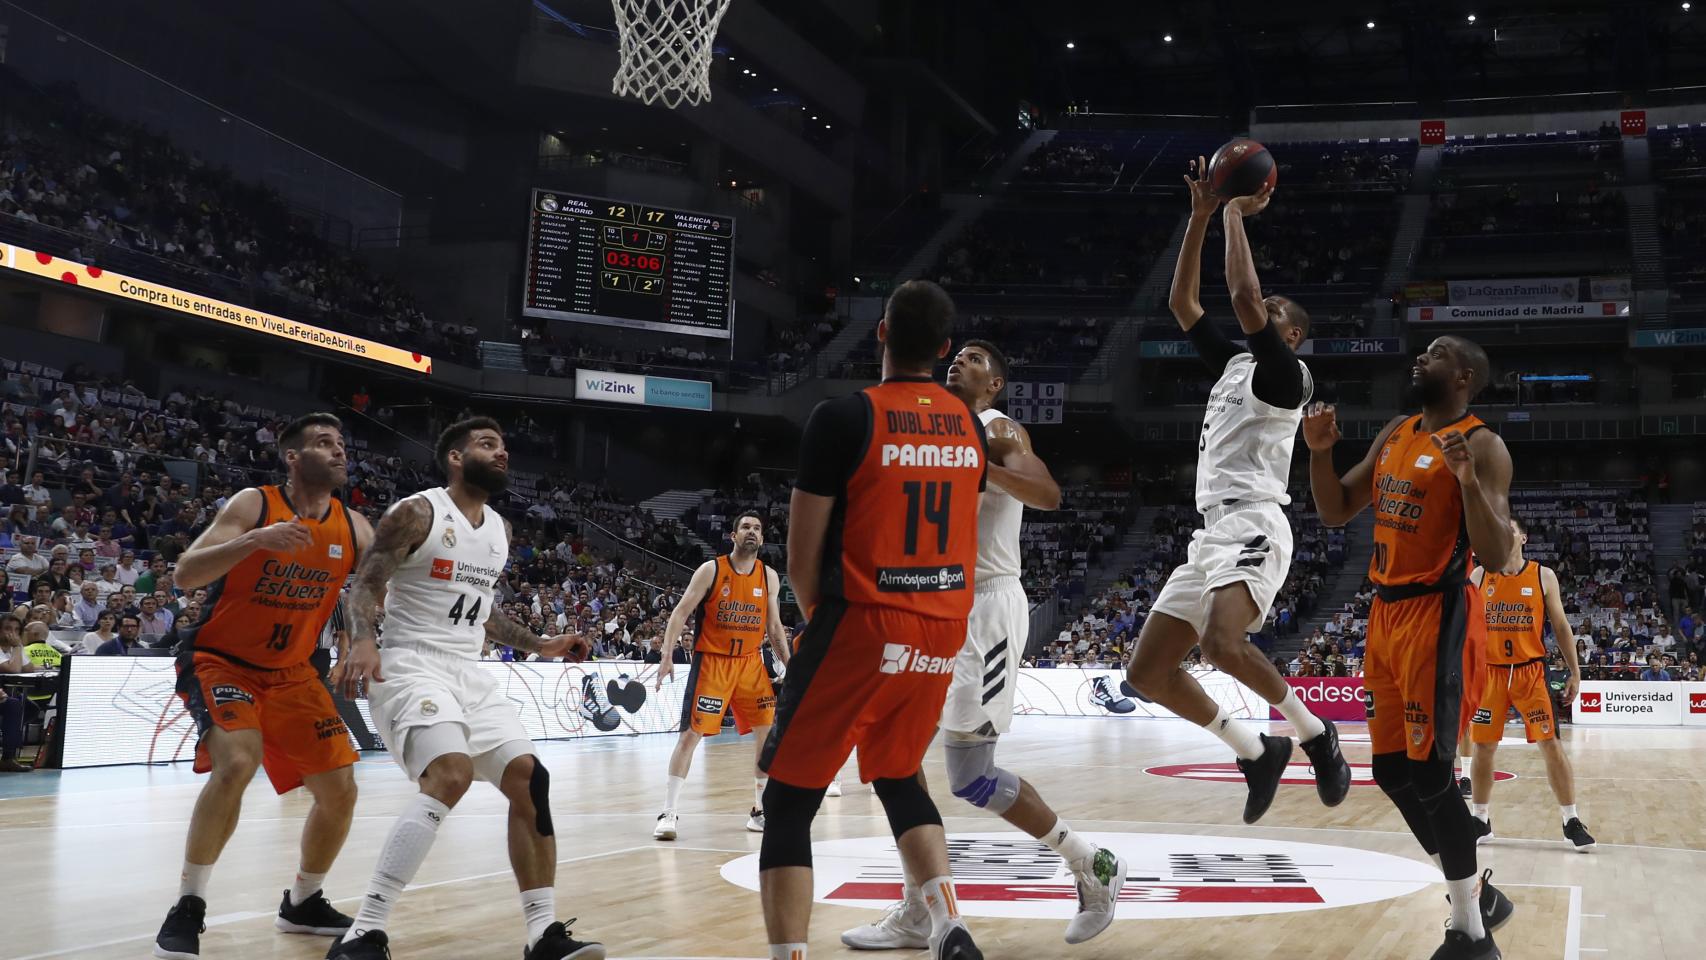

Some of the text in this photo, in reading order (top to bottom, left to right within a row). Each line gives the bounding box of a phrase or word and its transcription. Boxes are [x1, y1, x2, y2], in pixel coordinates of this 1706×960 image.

[567, 199, 589, 208] REAL
[561, 206, 594, 216] MADRID
[608, 205, 626, 218] 12
[646, 211, 665, 223] 17
[674, 213, 711, 225] VALENCIA
[677, 221, 708, 231] BASKET
[632, 231, 639, 242] 1
[607, 251, 661, 271] 03:06
[612, 276, 619, 287] 1
[643, 280, 653, 291] 2
[1467, 284, 1560, 297] LaGranFamilia
[119, 279, 366, 354] Compra tus entradas en ViveLaFeriaDeAbril.es
[1451, 305, 1585, 318] Comunidad de Madrid
[1330, 339, 1384, 353] WiZink
[585, 379, 636, 394] WiZink
[1015, 384, 1055, 398] 2 0
[1014, 407, 1054, 421] 0 9
[886, 410, 967, 436] DUBLJEVIC
[881, 443, 979, 469] PAMESA
[1378, 493, 1423, 520] fuerzo
[902, 480, 952, 556] 14
[263, 559, 330, 582] Cultura
[457, 561, 500, 578] Universida
[455, 573, 490, 588] Europea
[447, 593, 482, 627] 44
[718, 599, 756, 613] Cultura
[1485, 601, 1525, 613] Cultura
[716, 610, 761, 625] Esfuerzo
[1485, 612, 1534, 625] Esfuerzo
[265, 623, 293, 652] 19
[1504, 639, 1514, 658] 9
[1292, 681, 1364, 703] ndesa
[1605, 691, 1673, 702] Universidad
[1605, 703, 1654, 714] Europea
